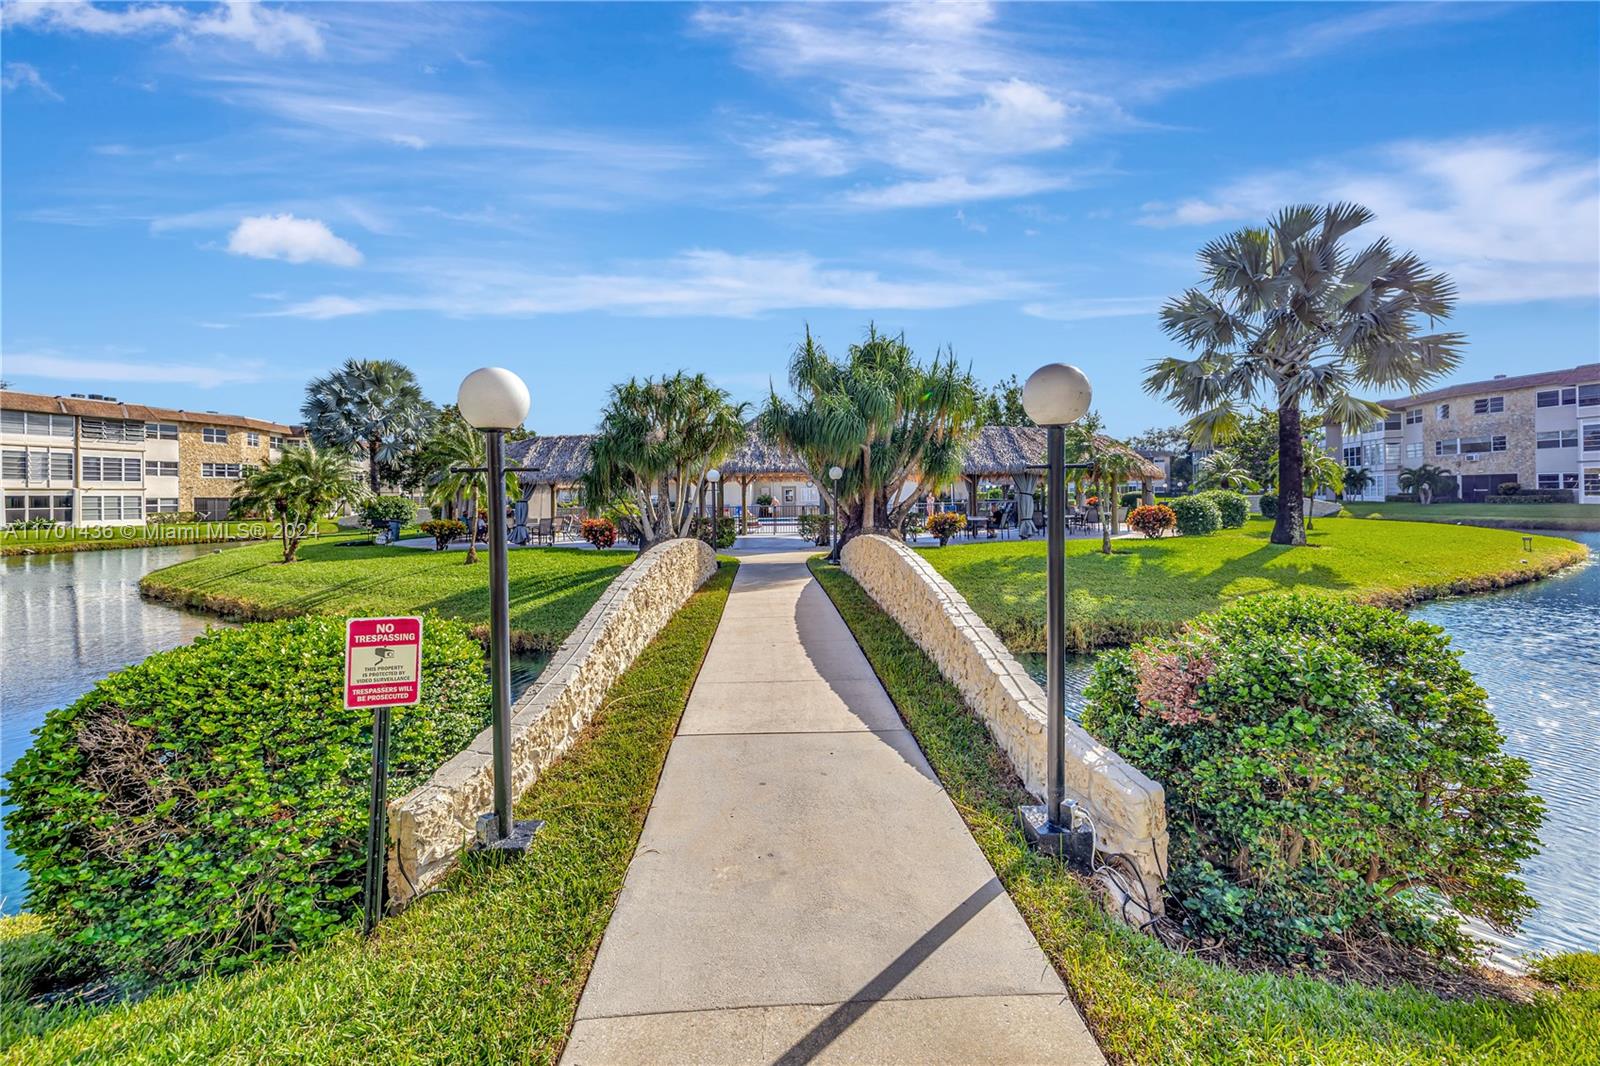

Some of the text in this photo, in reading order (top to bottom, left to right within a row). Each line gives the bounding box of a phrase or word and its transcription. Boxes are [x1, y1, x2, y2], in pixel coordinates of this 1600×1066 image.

[376, 623, 394, 633] NO
[354, 633, 415, 643] TRESPASSING
[352, 686, 397, 695] TRESPASSERS
[367, 693, 409, 701] PROSECUTED
